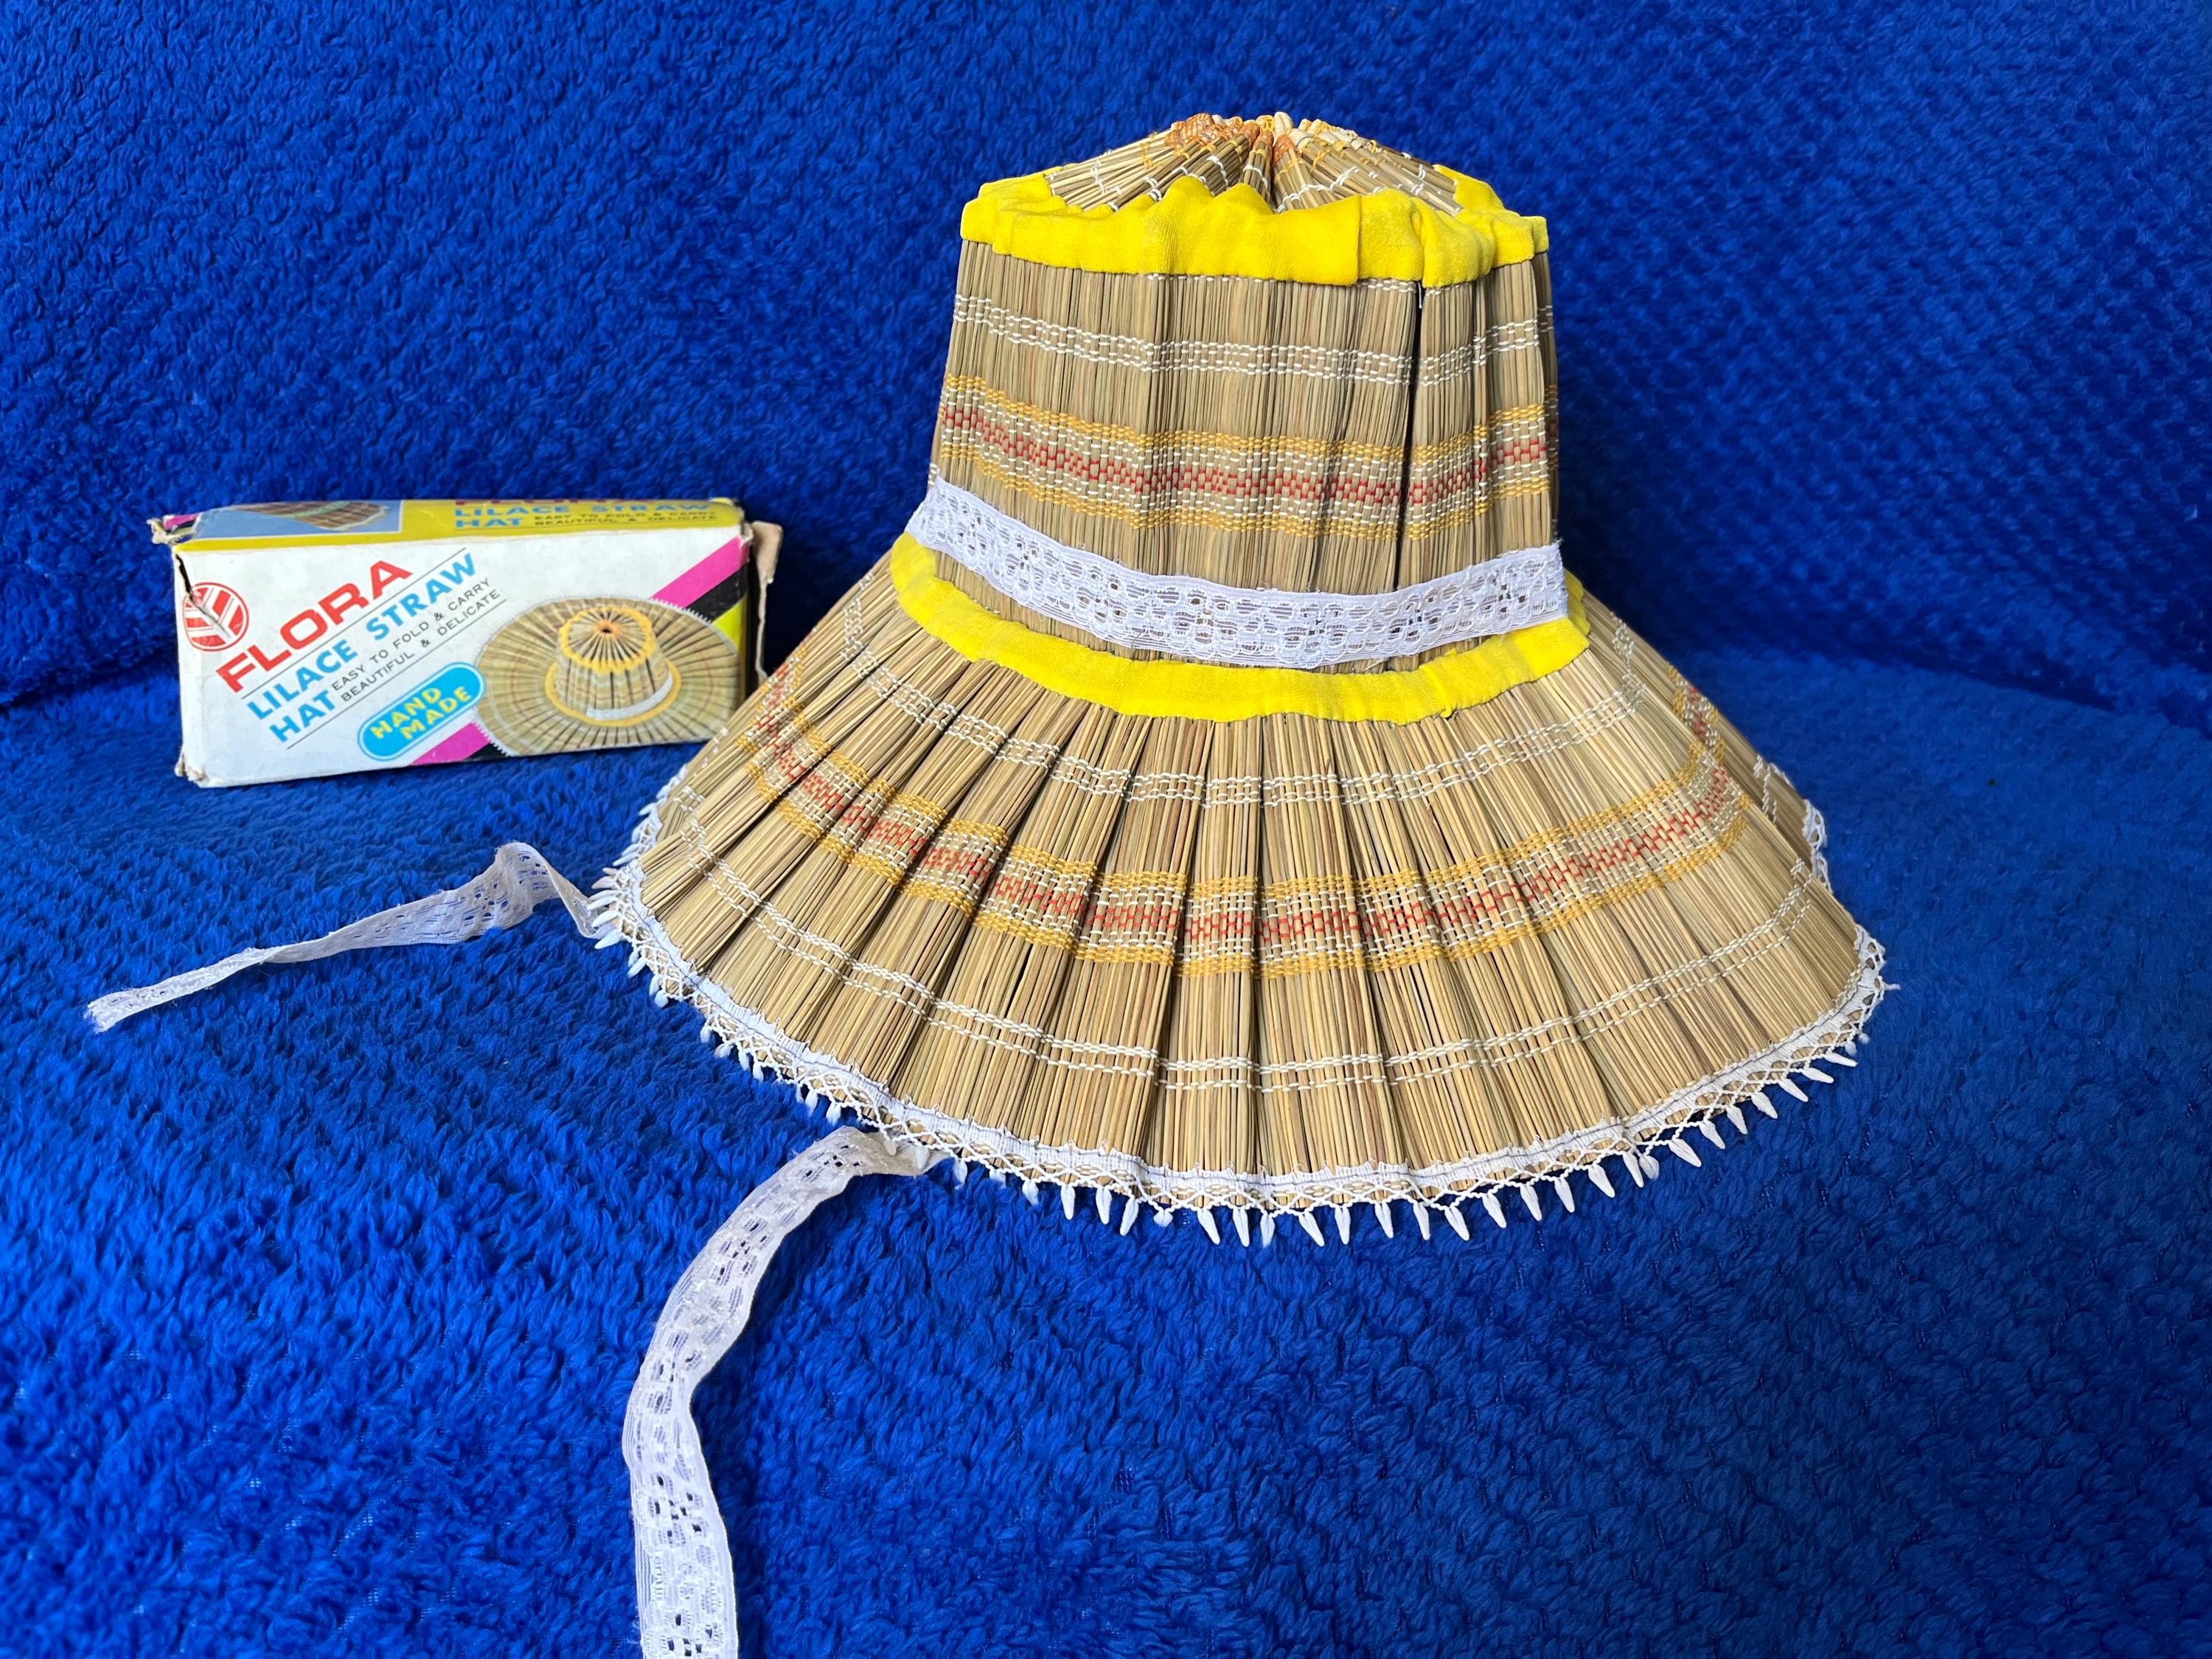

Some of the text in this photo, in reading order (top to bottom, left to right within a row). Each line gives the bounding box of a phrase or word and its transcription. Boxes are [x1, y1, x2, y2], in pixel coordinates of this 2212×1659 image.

[455, 506, 569, 516] LILACE
[456, 518, 524, 528] HAT
[215, 560, 413, 693] FLORA
[247, 553, 476, 720] LILACE STRAW
[269, 589, 501, 742] HAT BEAUTIFUL & DELICATE
[331, 578, 490, 691] EASY TO FOLD & CARRY
[370, 688, 441, 739] HAND
[400, 686, 472, 740] MADE
